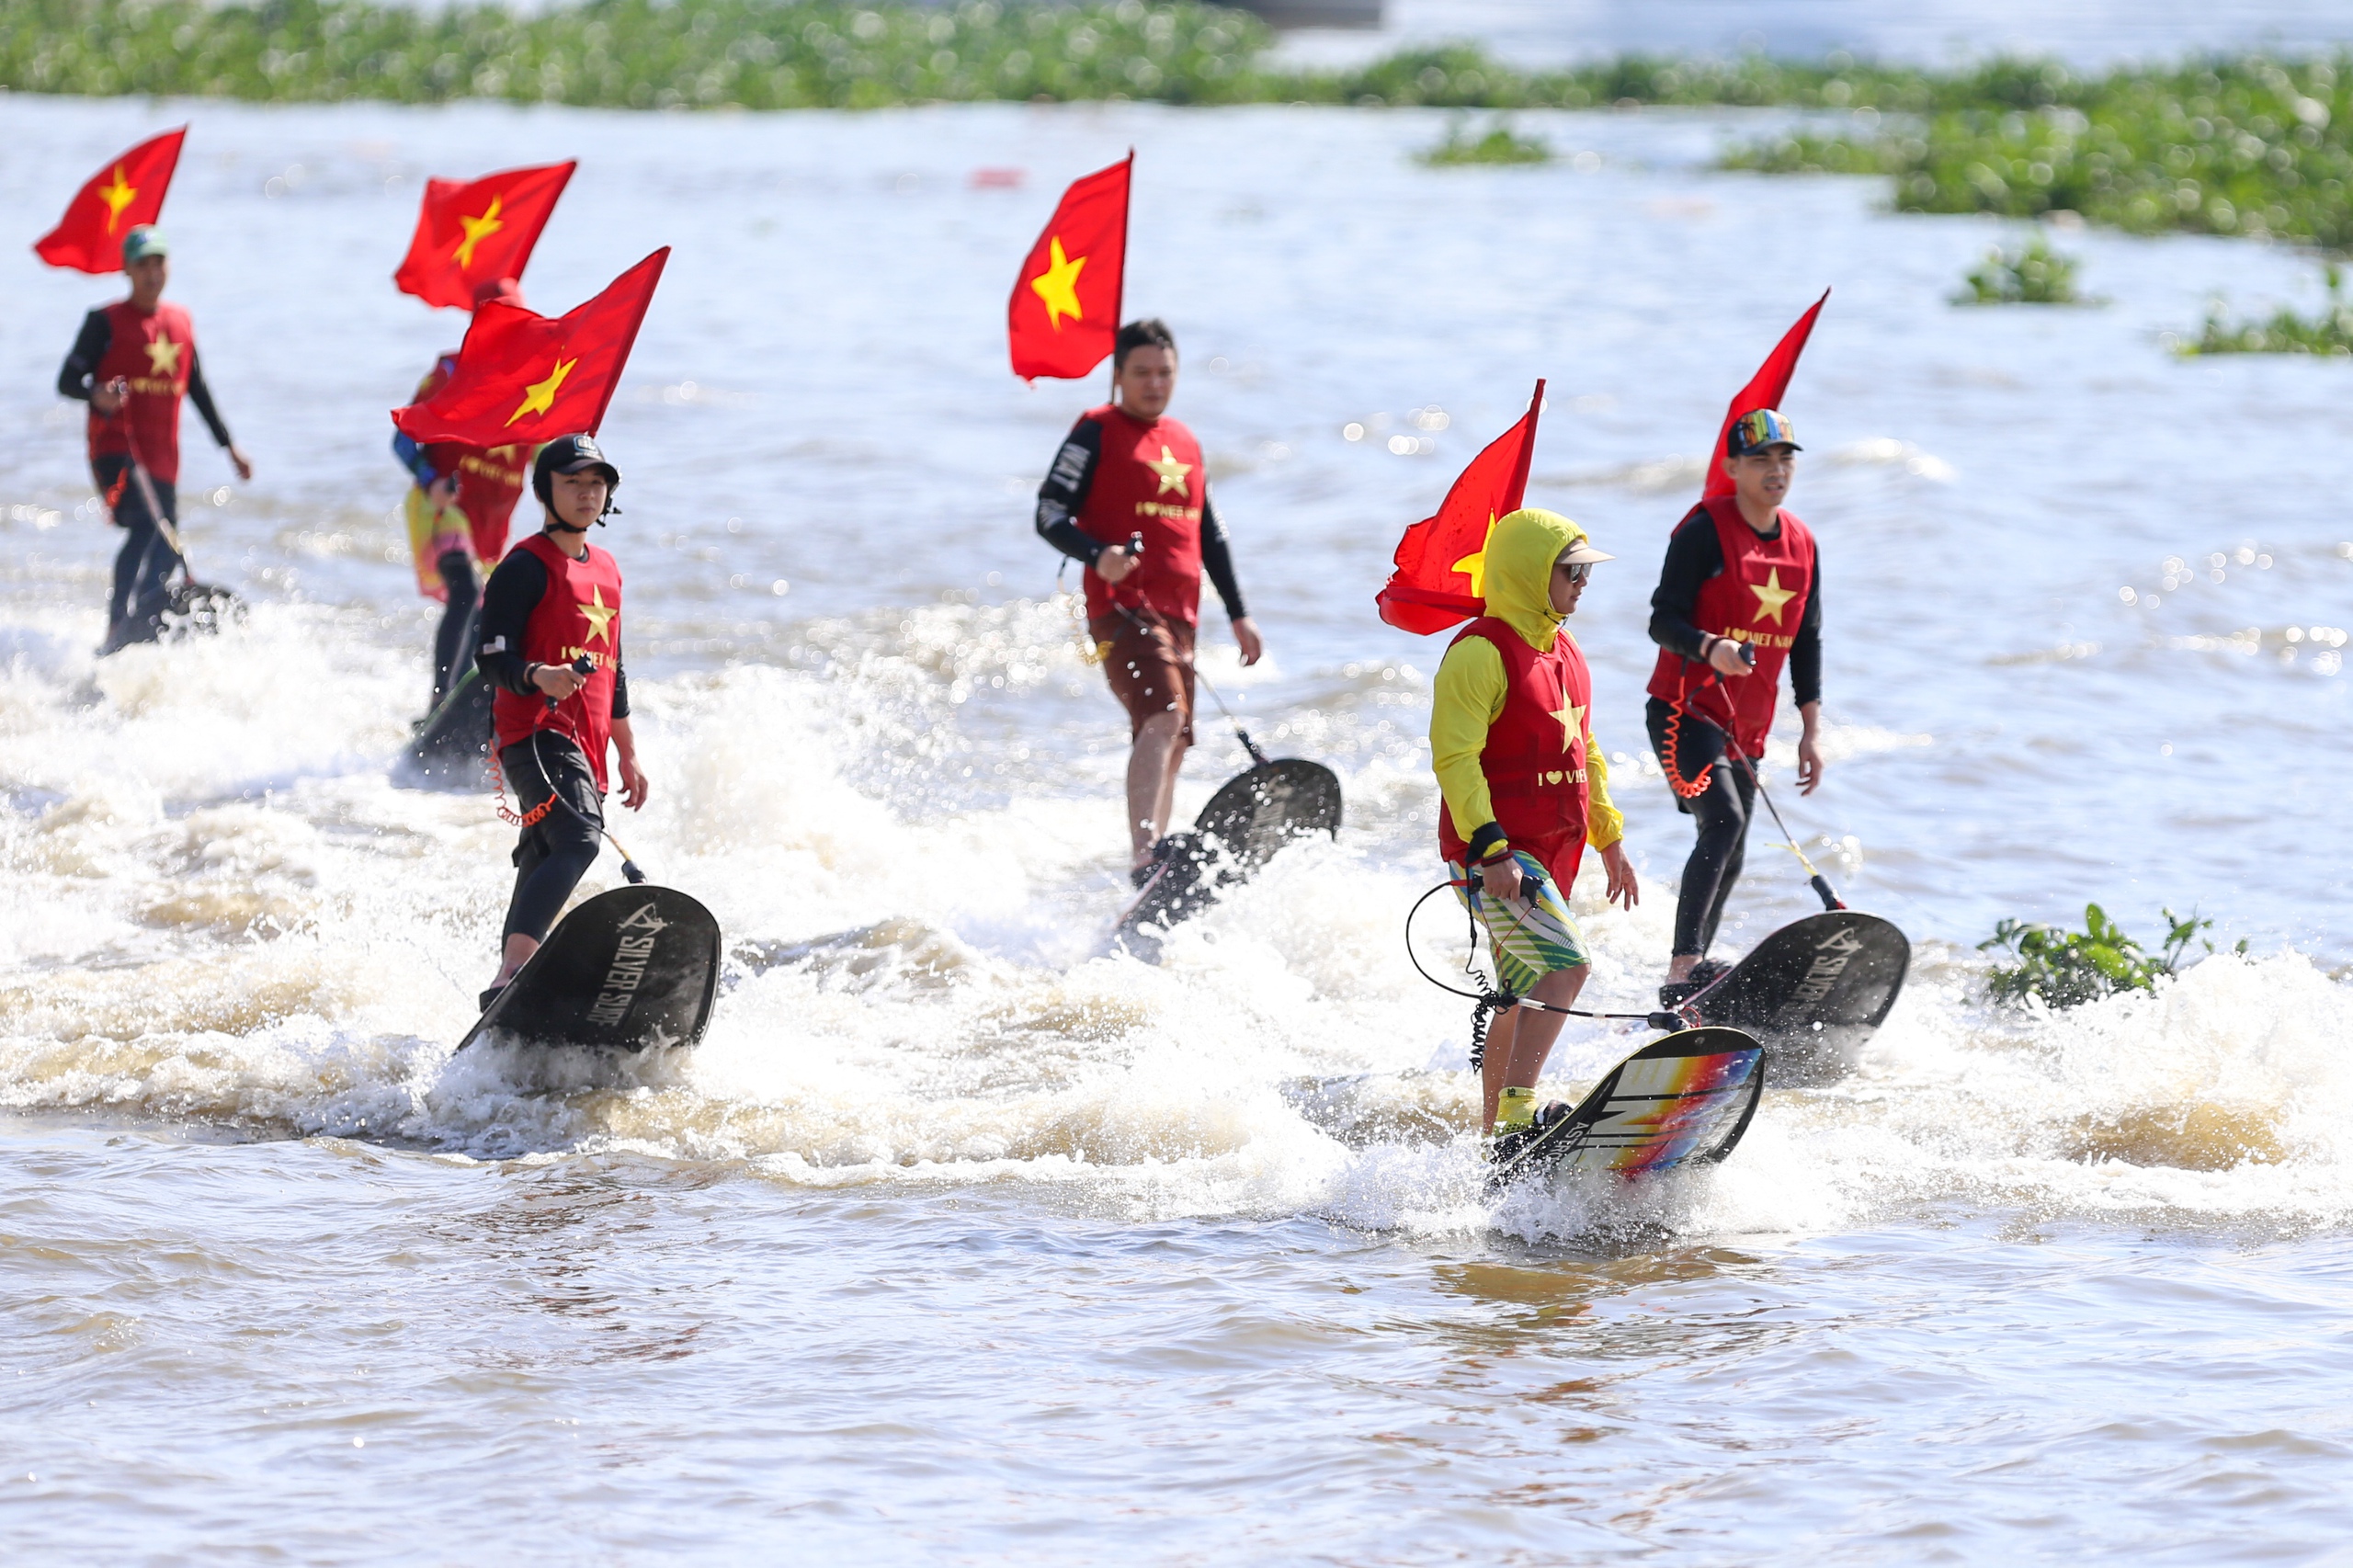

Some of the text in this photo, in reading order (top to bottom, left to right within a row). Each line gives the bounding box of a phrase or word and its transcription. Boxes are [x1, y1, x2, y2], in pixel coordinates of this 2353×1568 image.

[1538, 772, 1543, 787] I
[585, 936, 655, 1027] SILVER SURF
